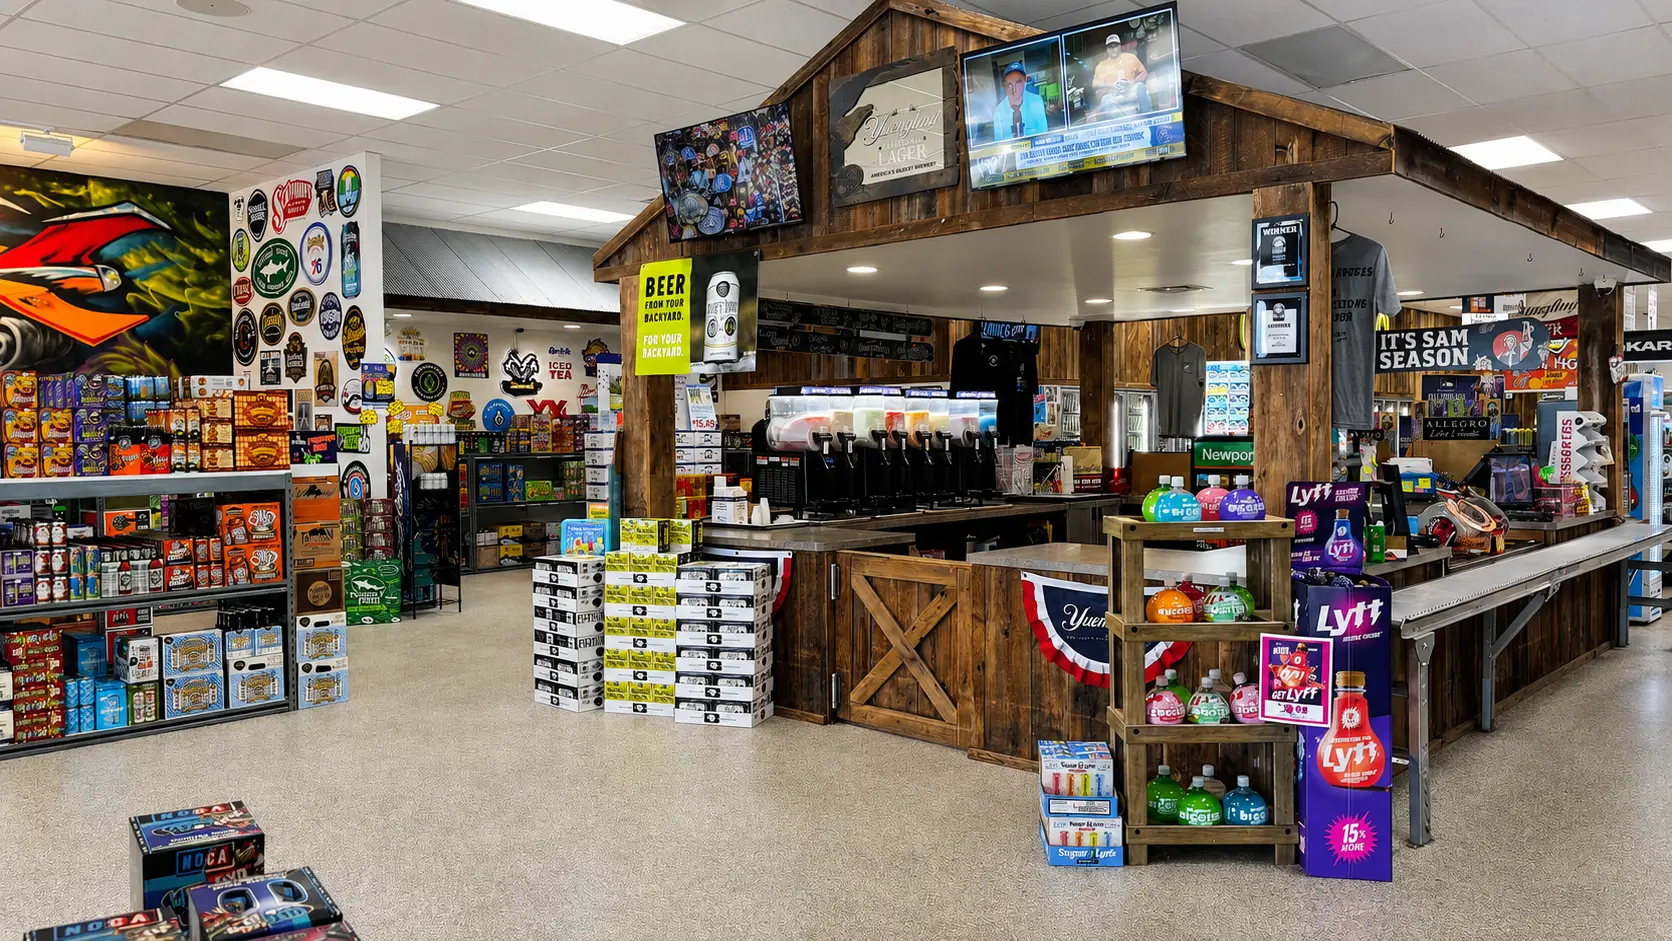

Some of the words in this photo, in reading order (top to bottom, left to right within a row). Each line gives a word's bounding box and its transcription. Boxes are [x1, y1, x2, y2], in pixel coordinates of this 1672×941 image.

[879, 144, 927, 166] LAGER
[645, 274, 686, 298] BEER
[643, 335, 658, 346] FOR
[661, 333, 682, 345] YOUR
[1380, 332, 1417, 350] IT'S
[1422, 329, 1469, 348] SAM
[549, 361, 572, 370] ICED
[1380, 347, 1469, 370] SEASON
[549, 370, 572, 380] TEA
[1426, 420, 1487, 428] ALLEGRO
[1202, 448, 1254, 463] Newpor
[1061, 604, 1107, 632] Yuen
[1272, 691, 1287, 701] GET
[1342, 822, 1367, 844] 15%
[1341, 843, 1365, 852] MORE
[183, 849, 227, 871] NOCA
